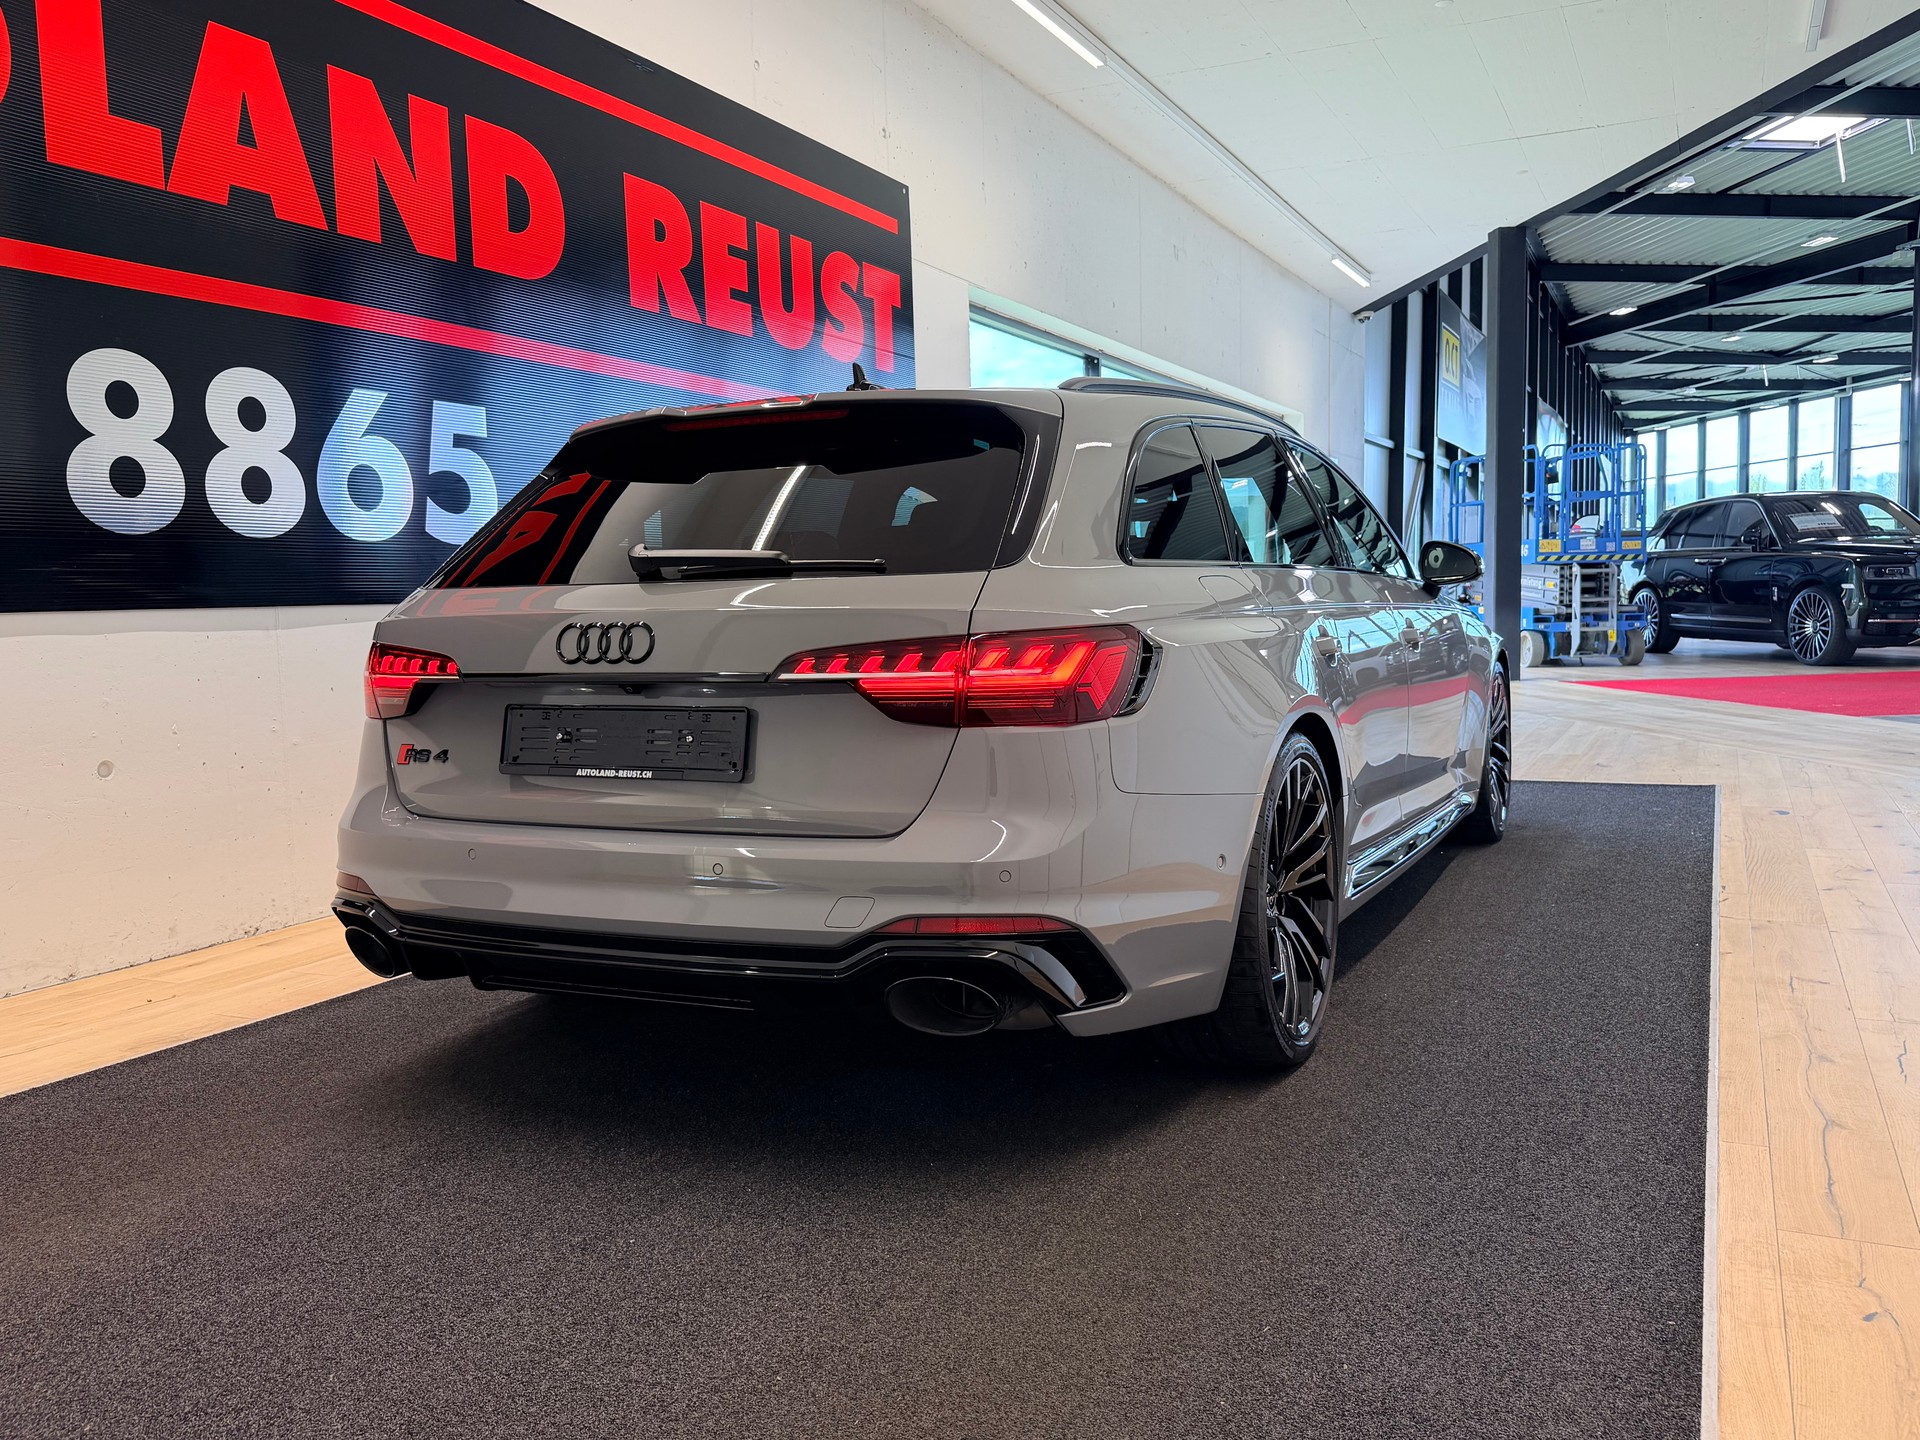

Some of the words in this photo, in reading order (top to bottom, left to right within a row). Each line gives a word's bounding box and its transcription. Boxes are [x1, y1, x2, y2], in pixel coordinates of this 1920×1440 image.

[0, 0, 566, 281] LAND
[624, 172, 902, 373] REUST
[66, 347, 499, 545] 8865
[397, 743, 432, 764] RS
[433, 749, 449, 763] 4
[576, 769, 653, 778] AUTOLAND-REUST.CH
